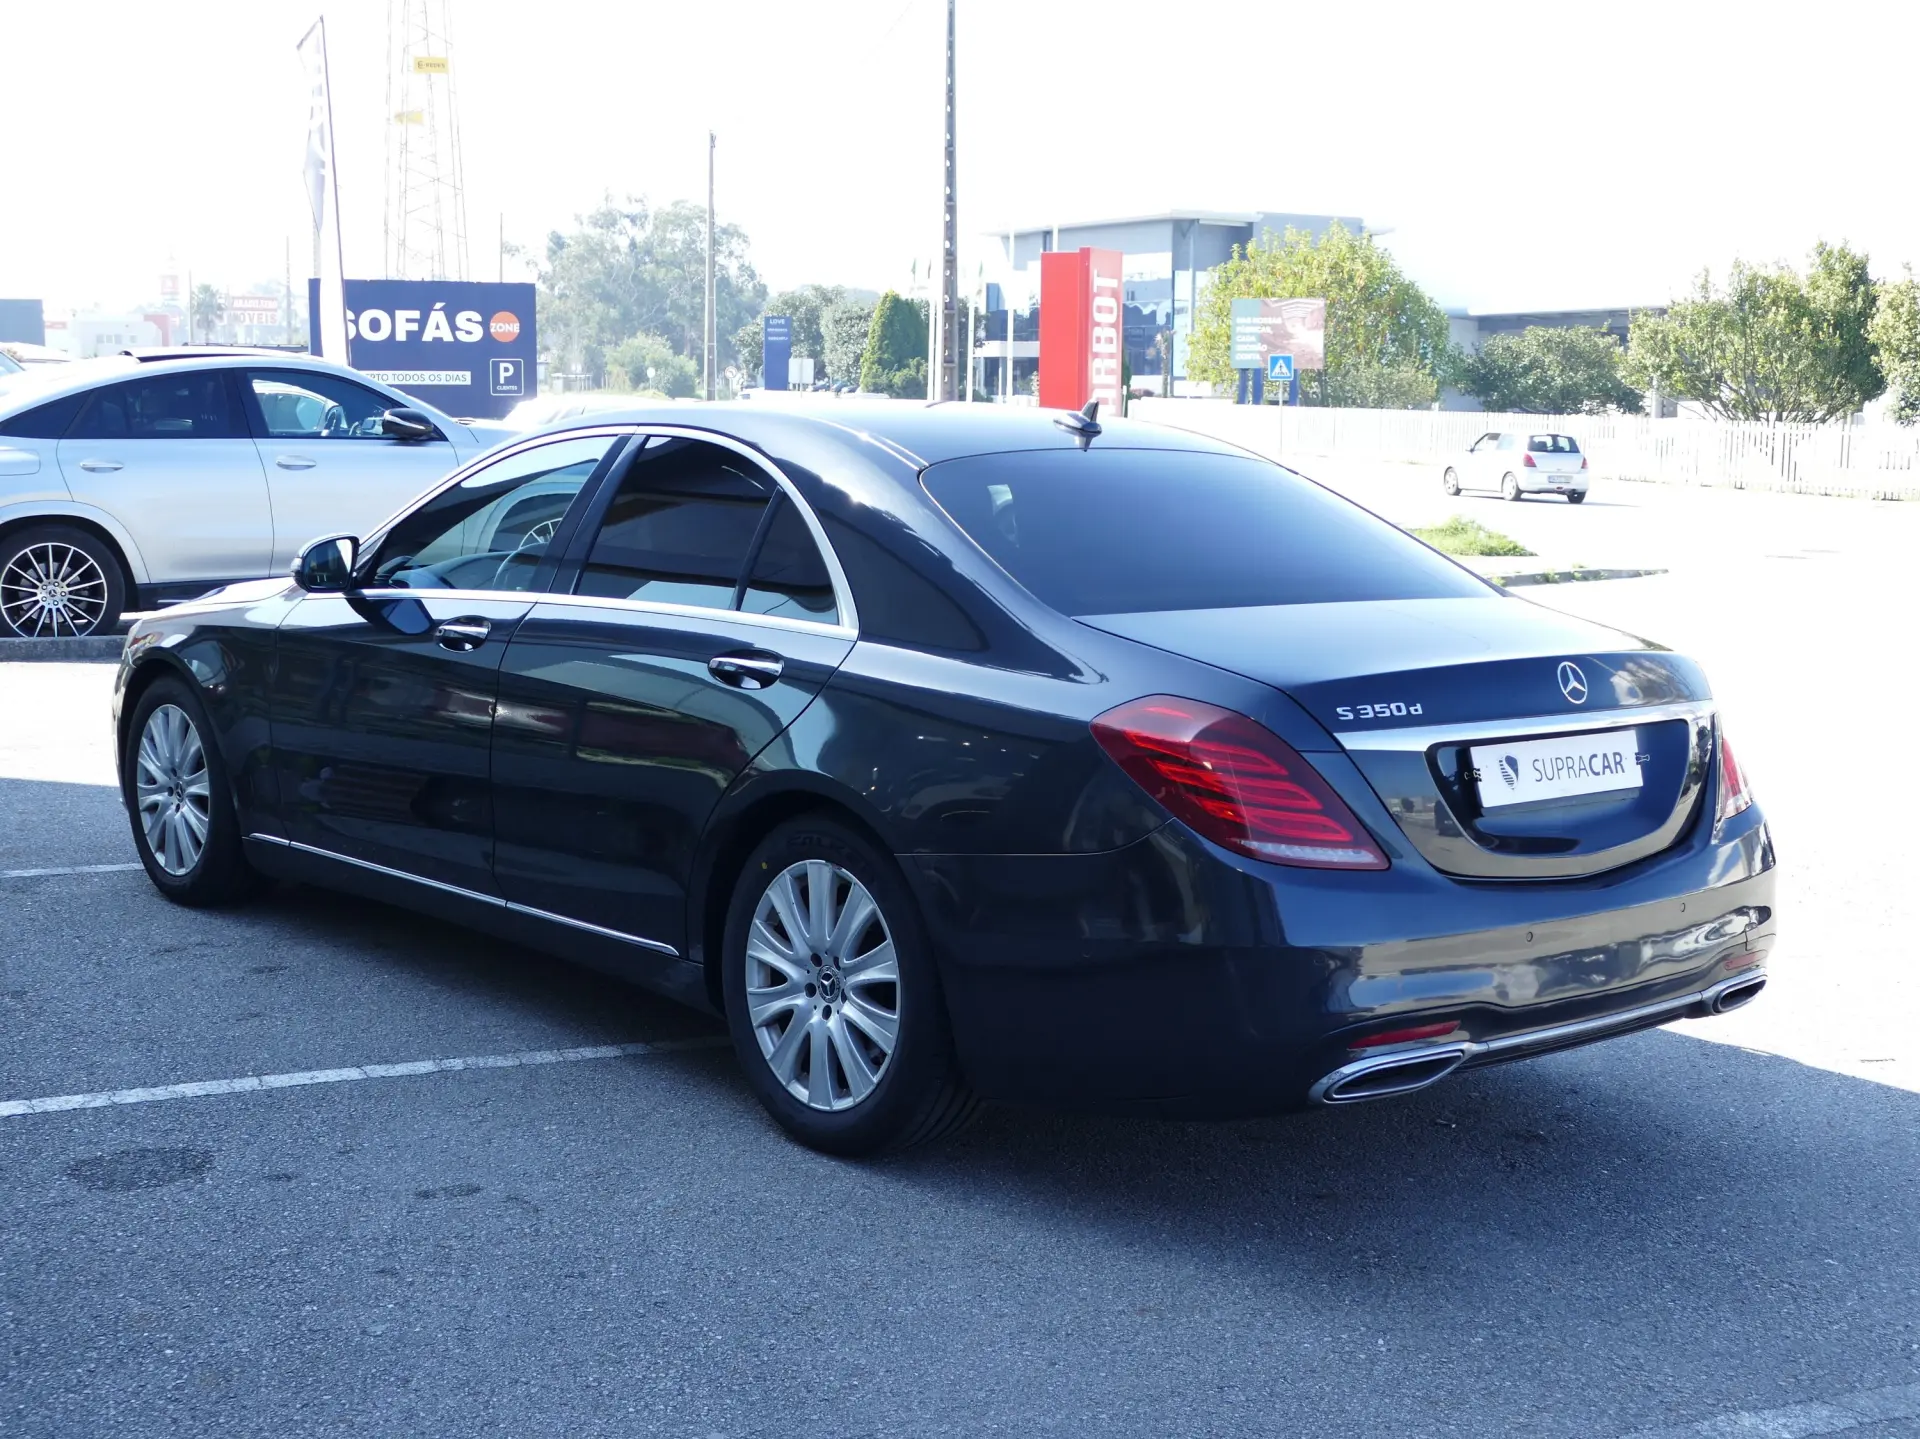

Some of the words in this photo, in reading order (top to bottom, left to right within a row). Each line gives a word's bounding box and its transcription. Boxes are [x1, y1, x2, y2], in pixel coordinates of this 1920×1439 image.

[490, 322, 520, 333] ZONE
[391, 373, 426, 382] TODOS
[428, 374, 442, 382] OS
[445, 374, 467, 382] DIAS
[499, 362, 514, 384] P
[1335, 705, 1354, 721] S
[1531, 750, 1627, 784] SUPRACAR
